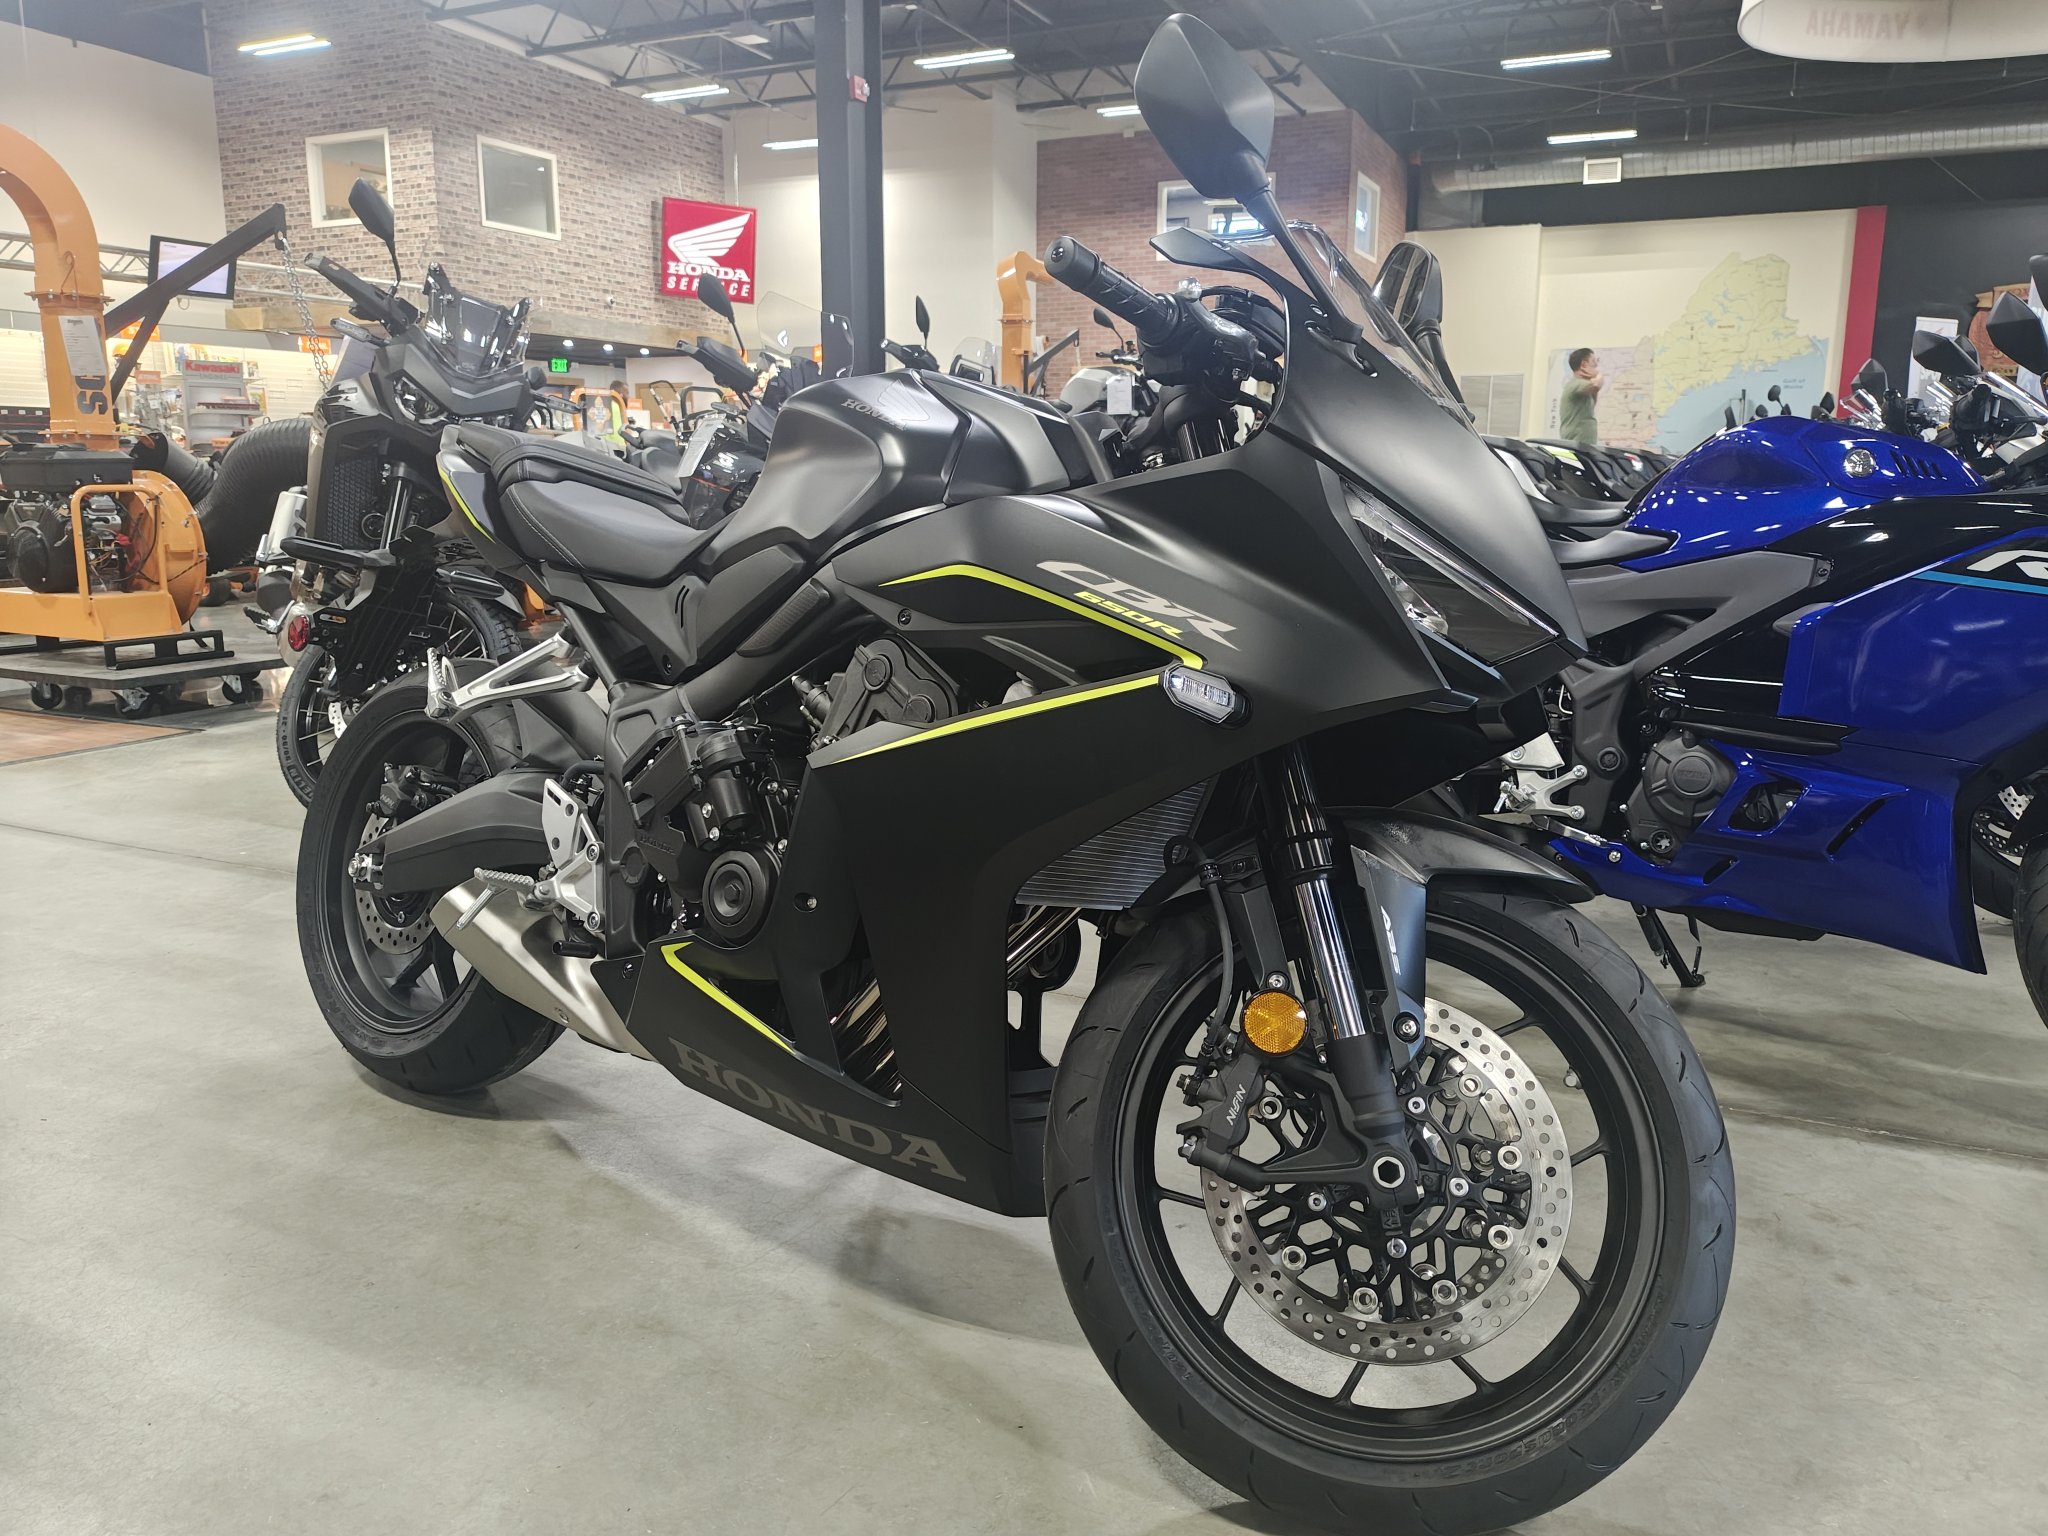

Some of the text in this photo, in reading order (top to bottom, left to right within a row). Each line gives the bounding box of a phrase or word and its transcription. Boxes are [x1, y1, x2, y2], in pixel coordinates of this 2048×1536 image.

[667, 261, 750, 282] HONDA
[185, 360, 240, 374] Kawasaki
[841, 398, 907, 431] HONDA
[1036, 560, 1241, 652] CBR
[1073, 590, 1184, 641] 650R
[1380, 905, 1401, 975] ABS
[668, 1036, 967, 1183] HONDA
[1226, 1083, 1246, 1126] NISSIN
